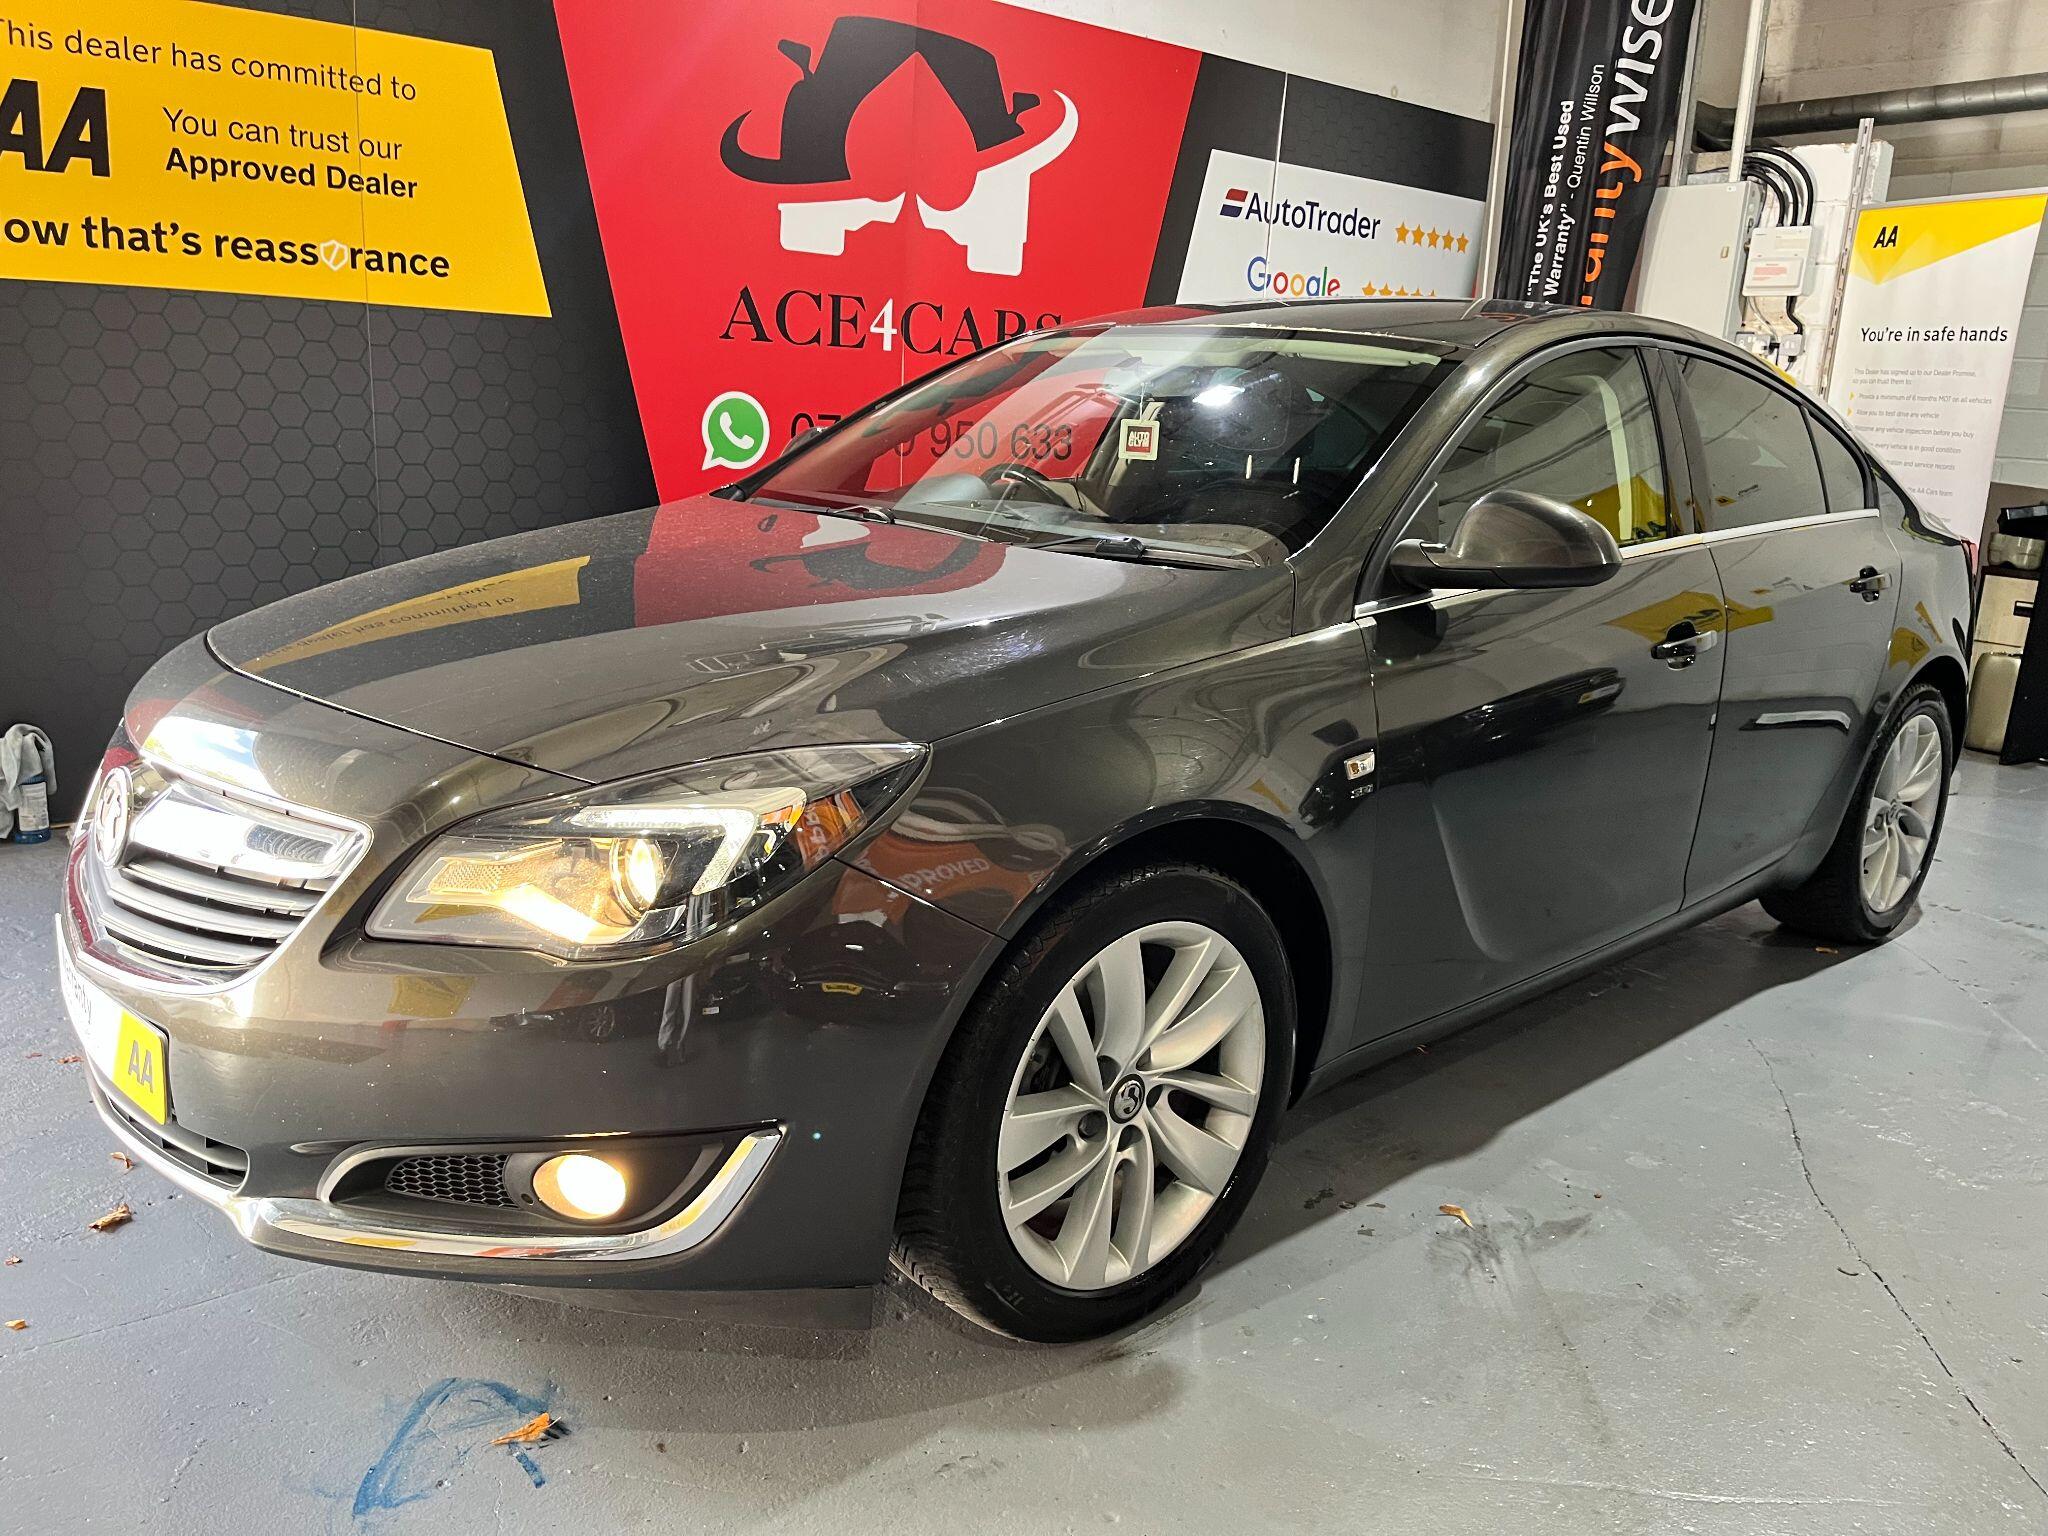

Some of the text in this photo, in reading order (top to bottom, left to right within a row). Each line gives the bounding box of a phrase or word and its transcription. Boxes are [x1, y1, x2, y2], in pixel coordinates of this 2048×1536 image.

[65, 29, 162, 64] dealer
[171, 43, 222, 72] has
[231, 57, 381, 96] committed
[391, 75, 417, 101] to
[0, 78, 111, 178] AA
[162, 107, 402, 161] You can trust our
[1553, 100, 1575, 150] Used
[1567, 126, 1592, 189] Quentin
[1581, 64, 1605, 121] Willson
[166, 148, 418, 199] Approved Dealer
[1544, 154, 1564, 198] Best
[1245, 192, 1381, 240] AutoTrader
[1873, 225, 1899, 248] AA
[4, 218, 69, 246] ow
[214, 232, 450, 279] reassrance
[1906, 326, 1920, 342] in
[1924, 326, 1956, 342] safe
[1959, 326, 2008, 342] hands
[930, 421, 998, 460] 950
[1011, 423, 1072, 460] 633
[1129, 431, 1150, 440] AUTO
[128, 1040, 153, 1093] AA
